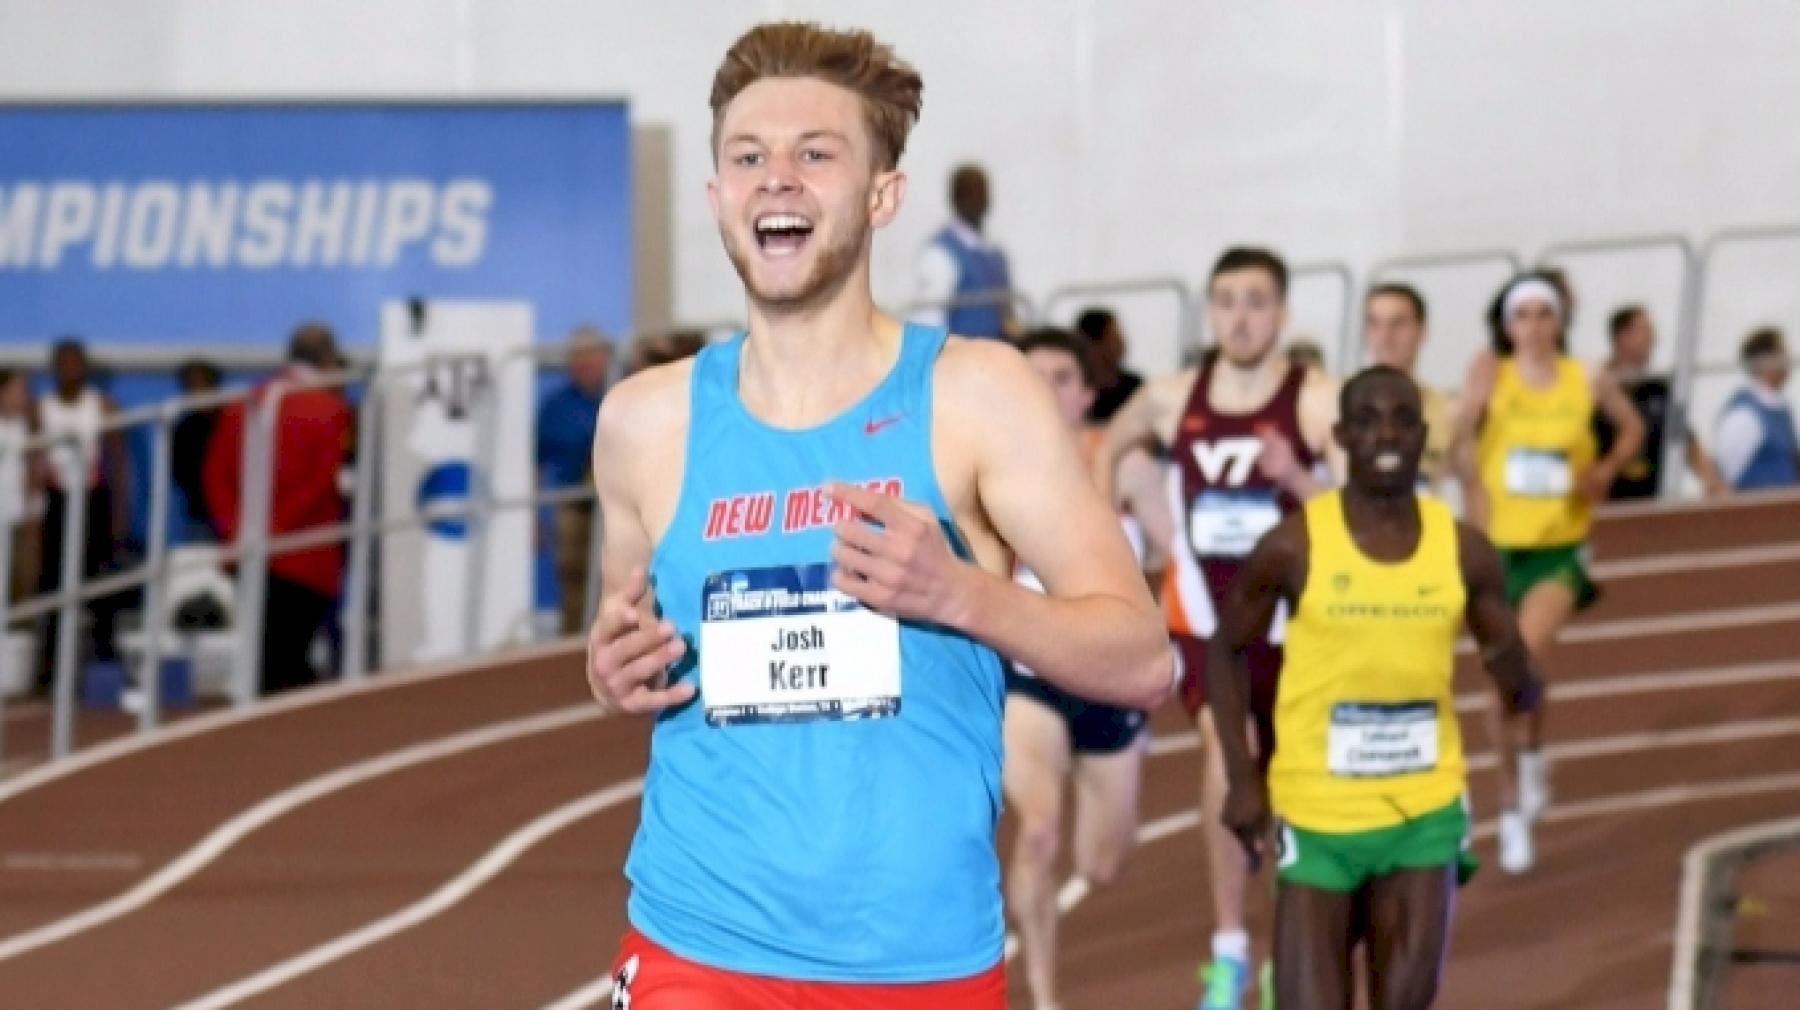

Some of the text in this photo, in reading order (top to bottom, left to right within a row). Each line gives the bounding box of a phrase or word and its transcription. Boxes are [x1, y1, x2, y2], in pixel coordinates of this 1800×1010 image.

[1192, 438, 1264, 487] VT
[703, 477, 903, 541] NEW MEX
[771, 625, 825, 652] Josh
[768, 659, 830, 691] Kerr
